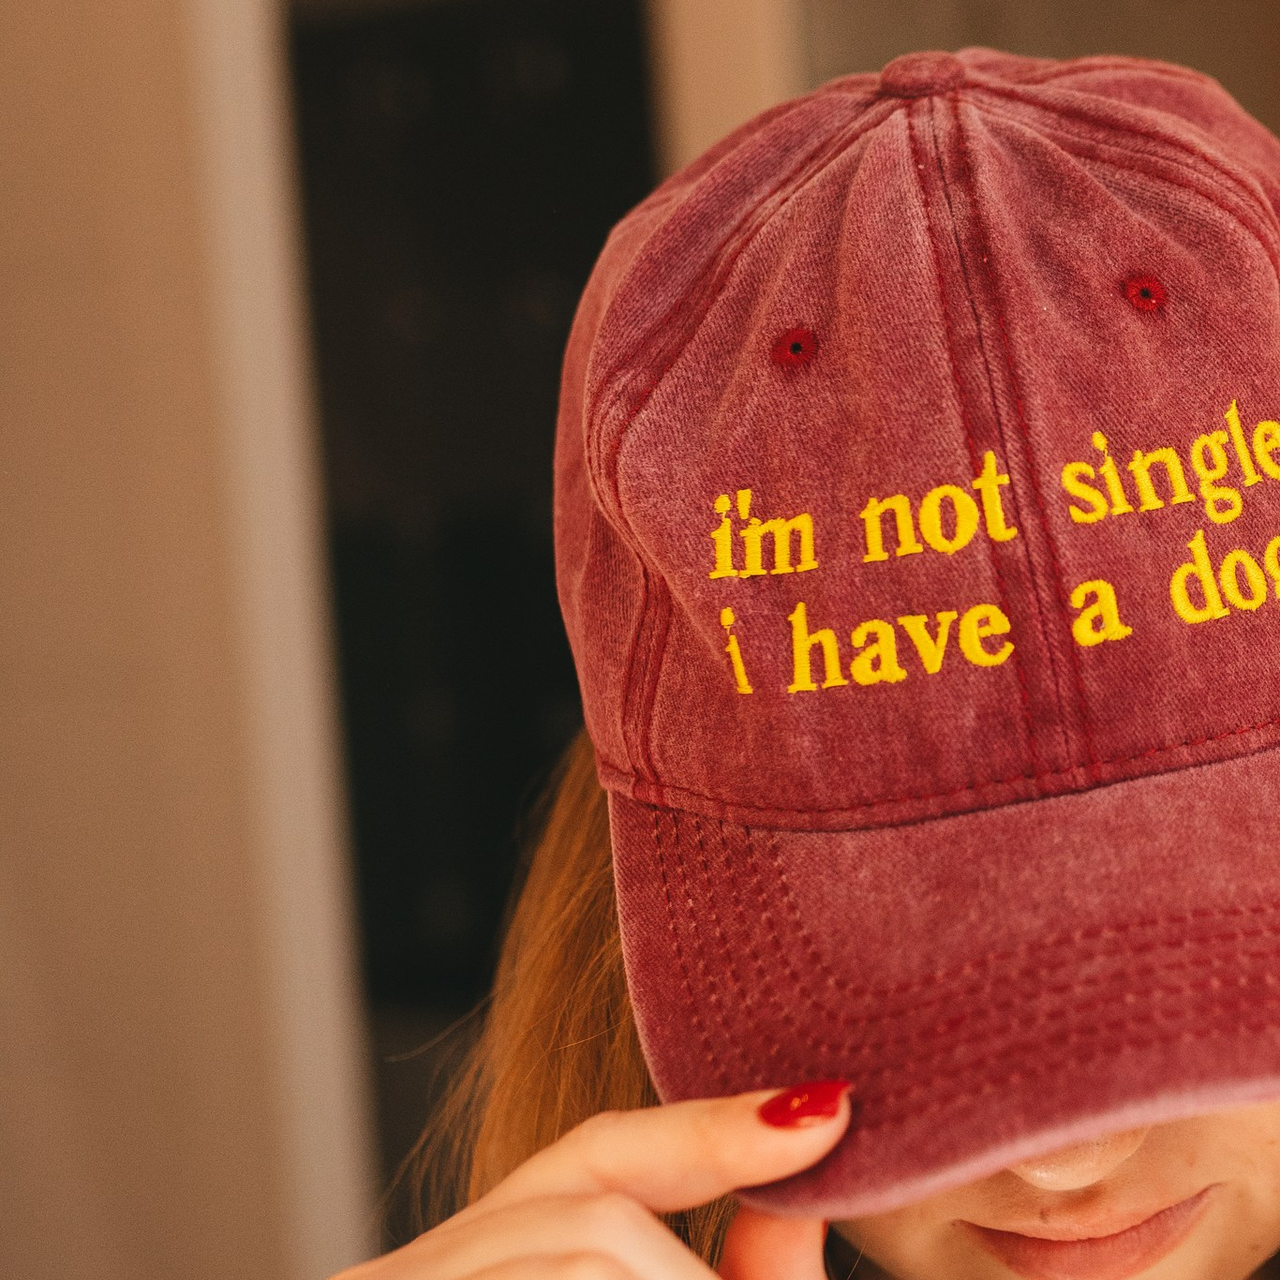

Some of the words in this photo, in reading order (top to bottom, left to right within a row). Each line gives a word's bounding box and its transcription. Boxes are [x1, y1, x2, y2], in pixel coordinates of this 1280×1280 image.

[708, 488, 819, 580] i'm
[858, 450, 1018, 563] not
[719, 606, 754, 695] i
[787, 601, 1016, 695] have
[1070, 578, 1133, 647] a
